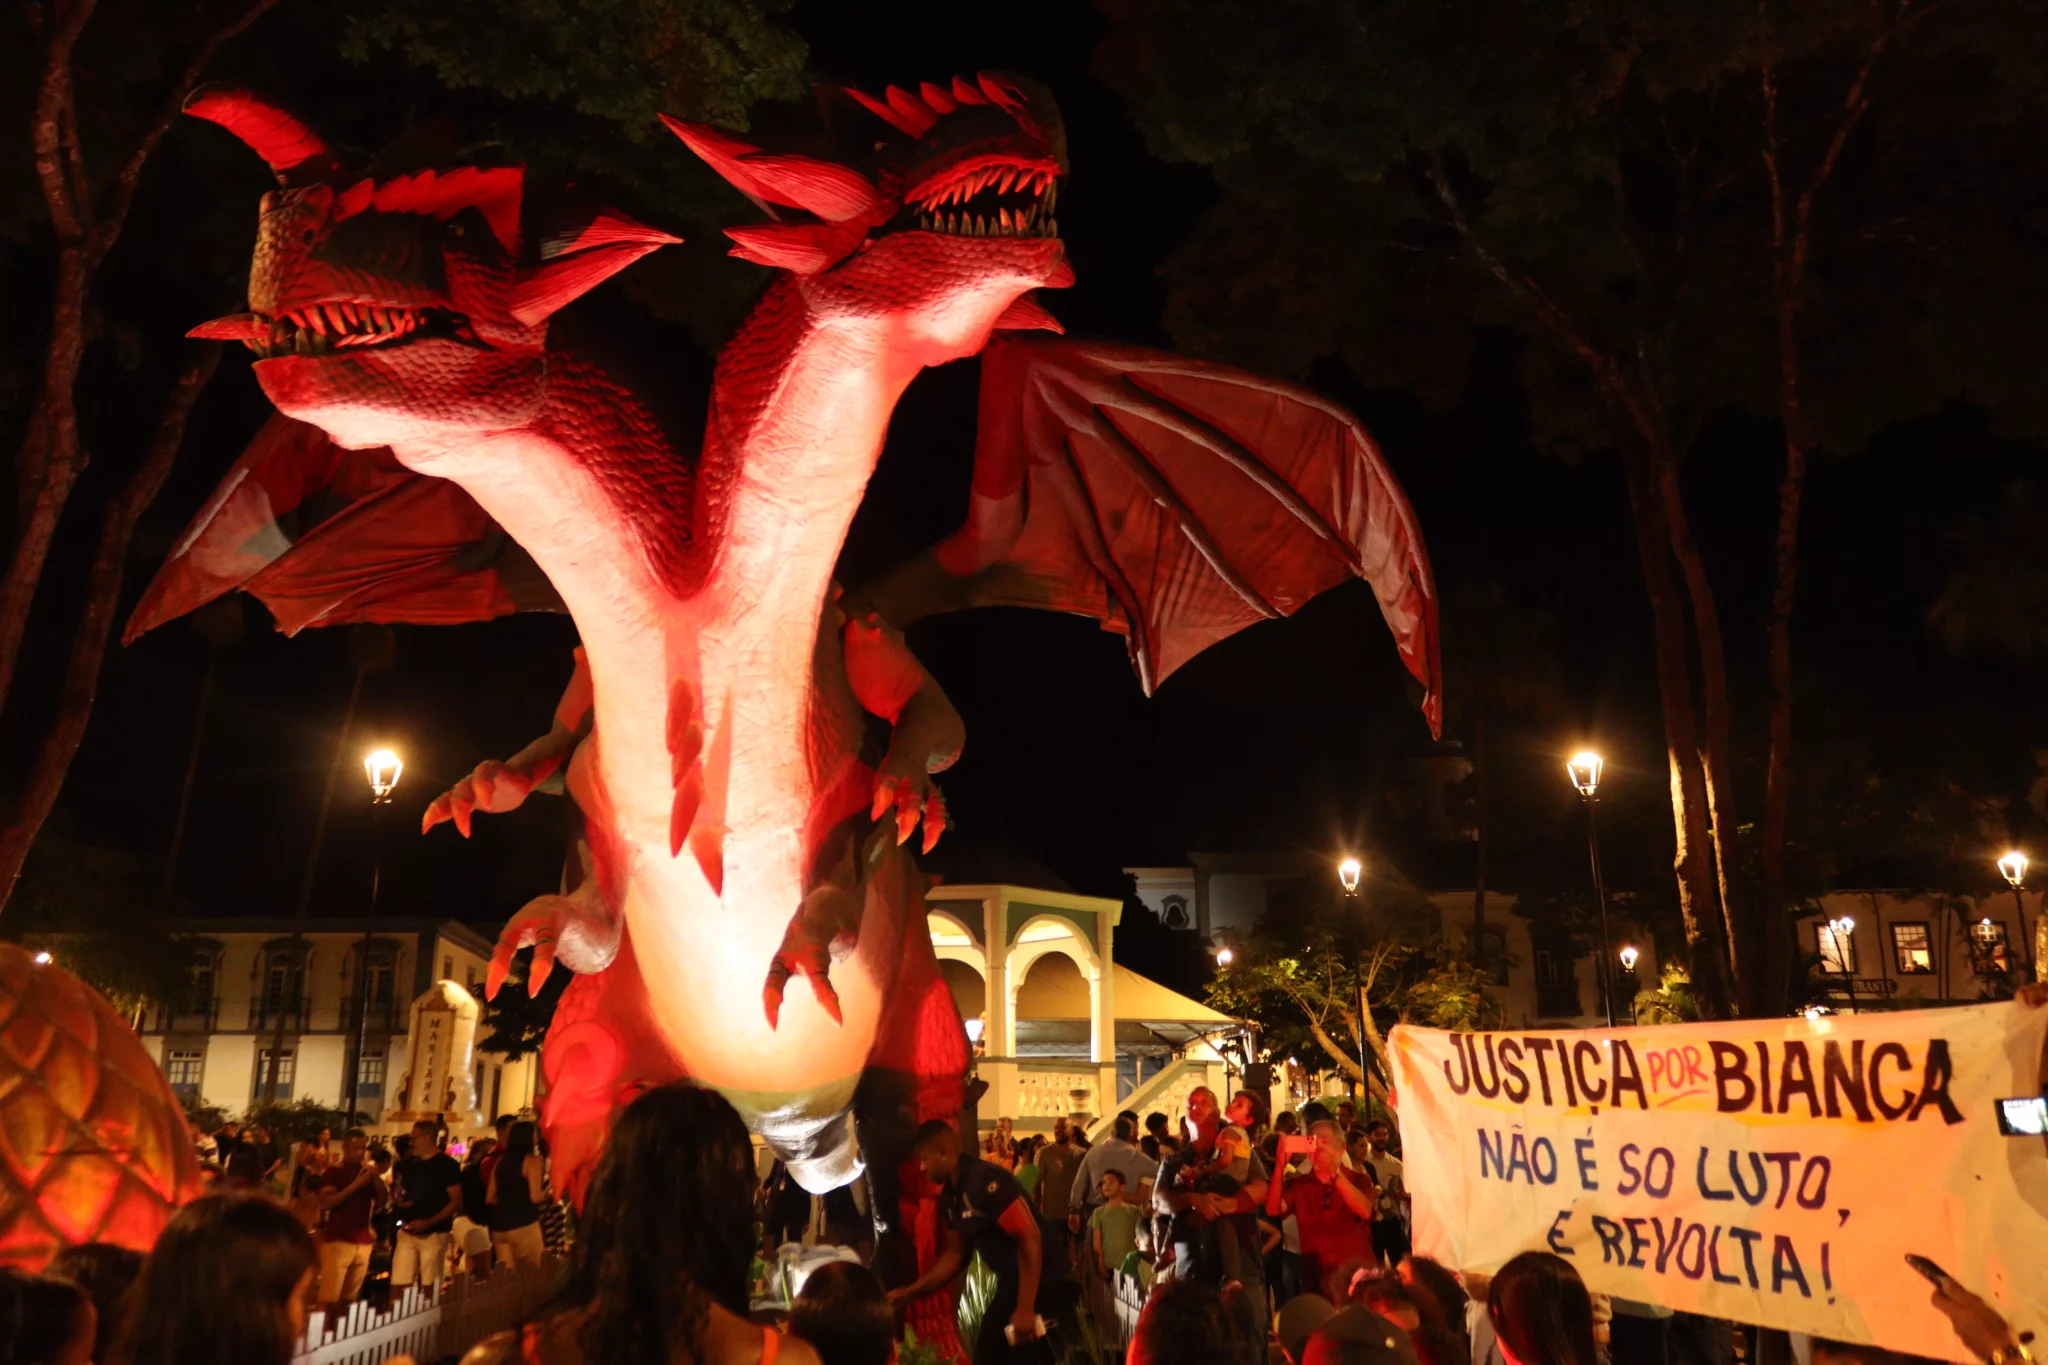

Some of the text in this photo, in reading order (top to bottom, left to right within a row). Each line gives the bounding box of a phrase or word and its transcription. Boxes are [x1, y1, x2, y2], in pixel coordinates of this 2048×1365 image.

[1444, 1033, 1966, 1126] JUSTIÇA POR BIANCA
[1477, 1124, 1557, 1185] NÃO
[1574, 1127, 1599, 1190] É
[1592, 1216, 1835, 1304] REVOLTA!
